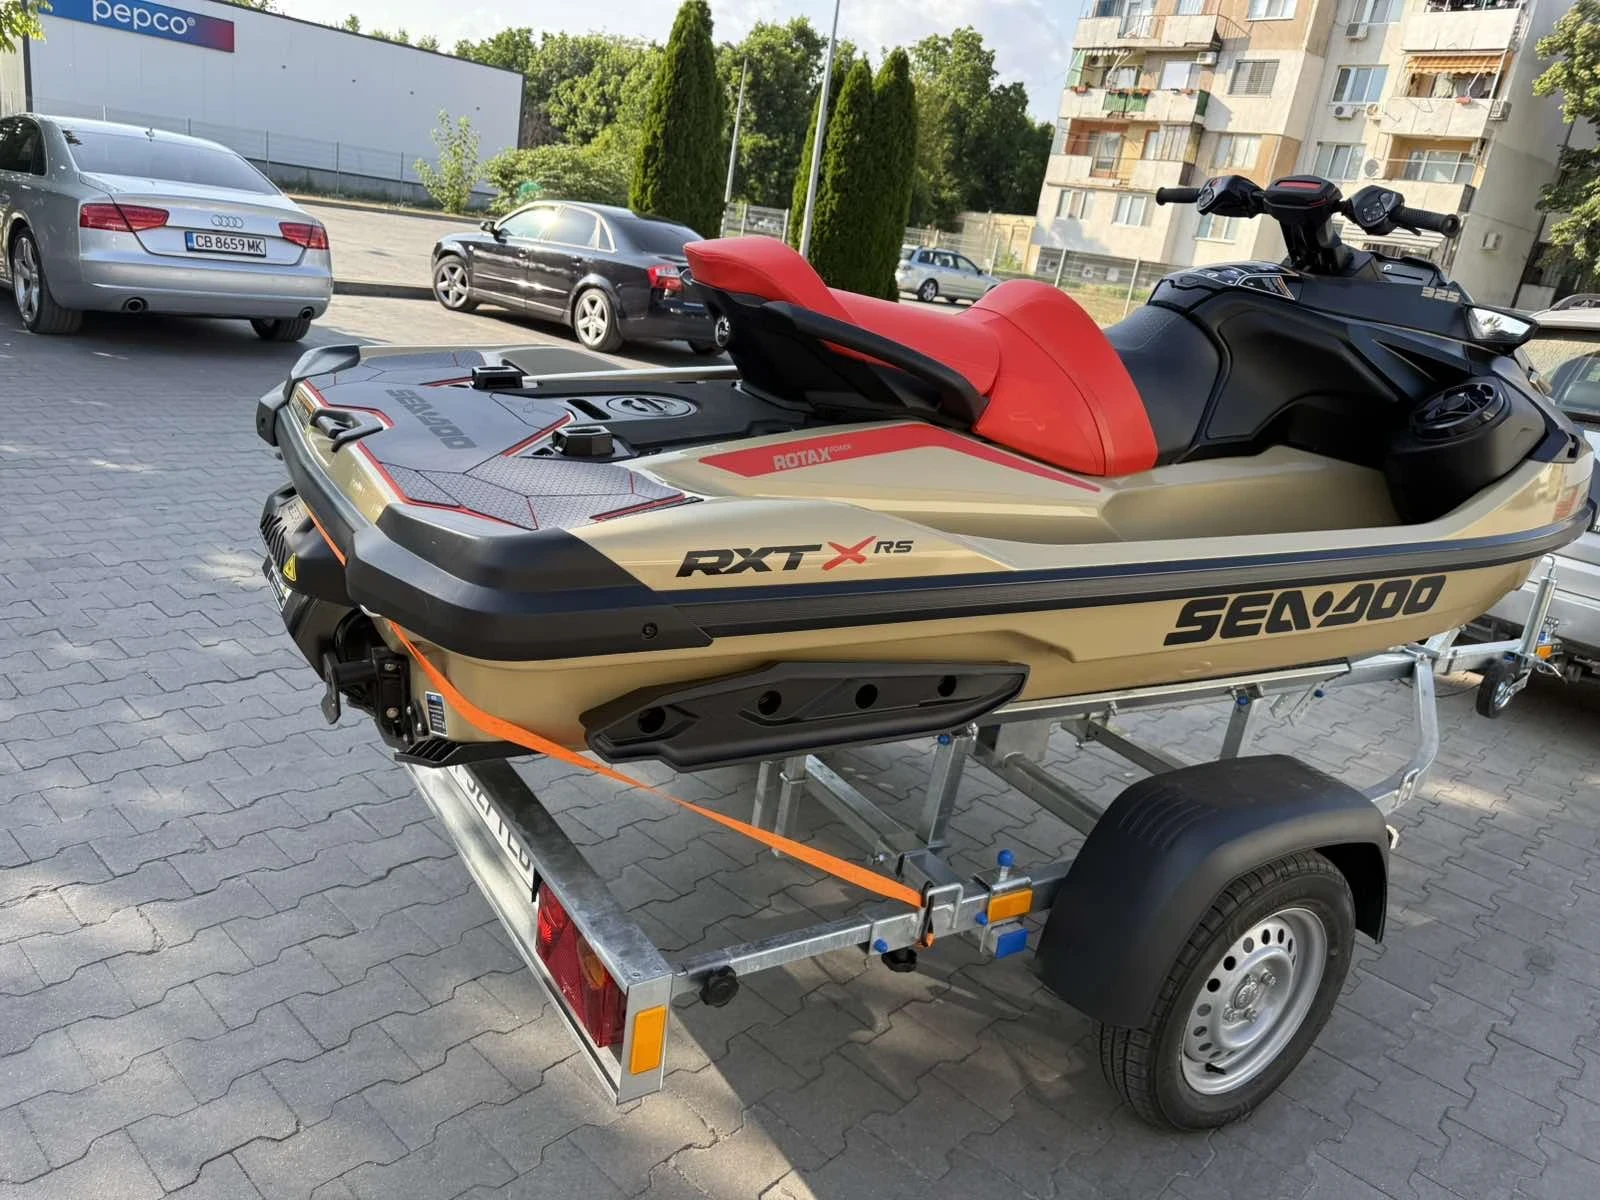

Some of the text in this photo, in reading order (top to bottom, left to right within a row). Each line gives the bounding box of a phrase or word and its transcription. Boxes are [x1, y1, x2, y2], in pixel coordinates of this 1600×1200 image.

[195, 235, 263, 253] CB 8659 MK
[1421, 286, 1461, 303] 325
[773, 447, 831, 470] ROTAX
[675, 544, 822, 577] RXT
[874, 540, 914, 554] RS
